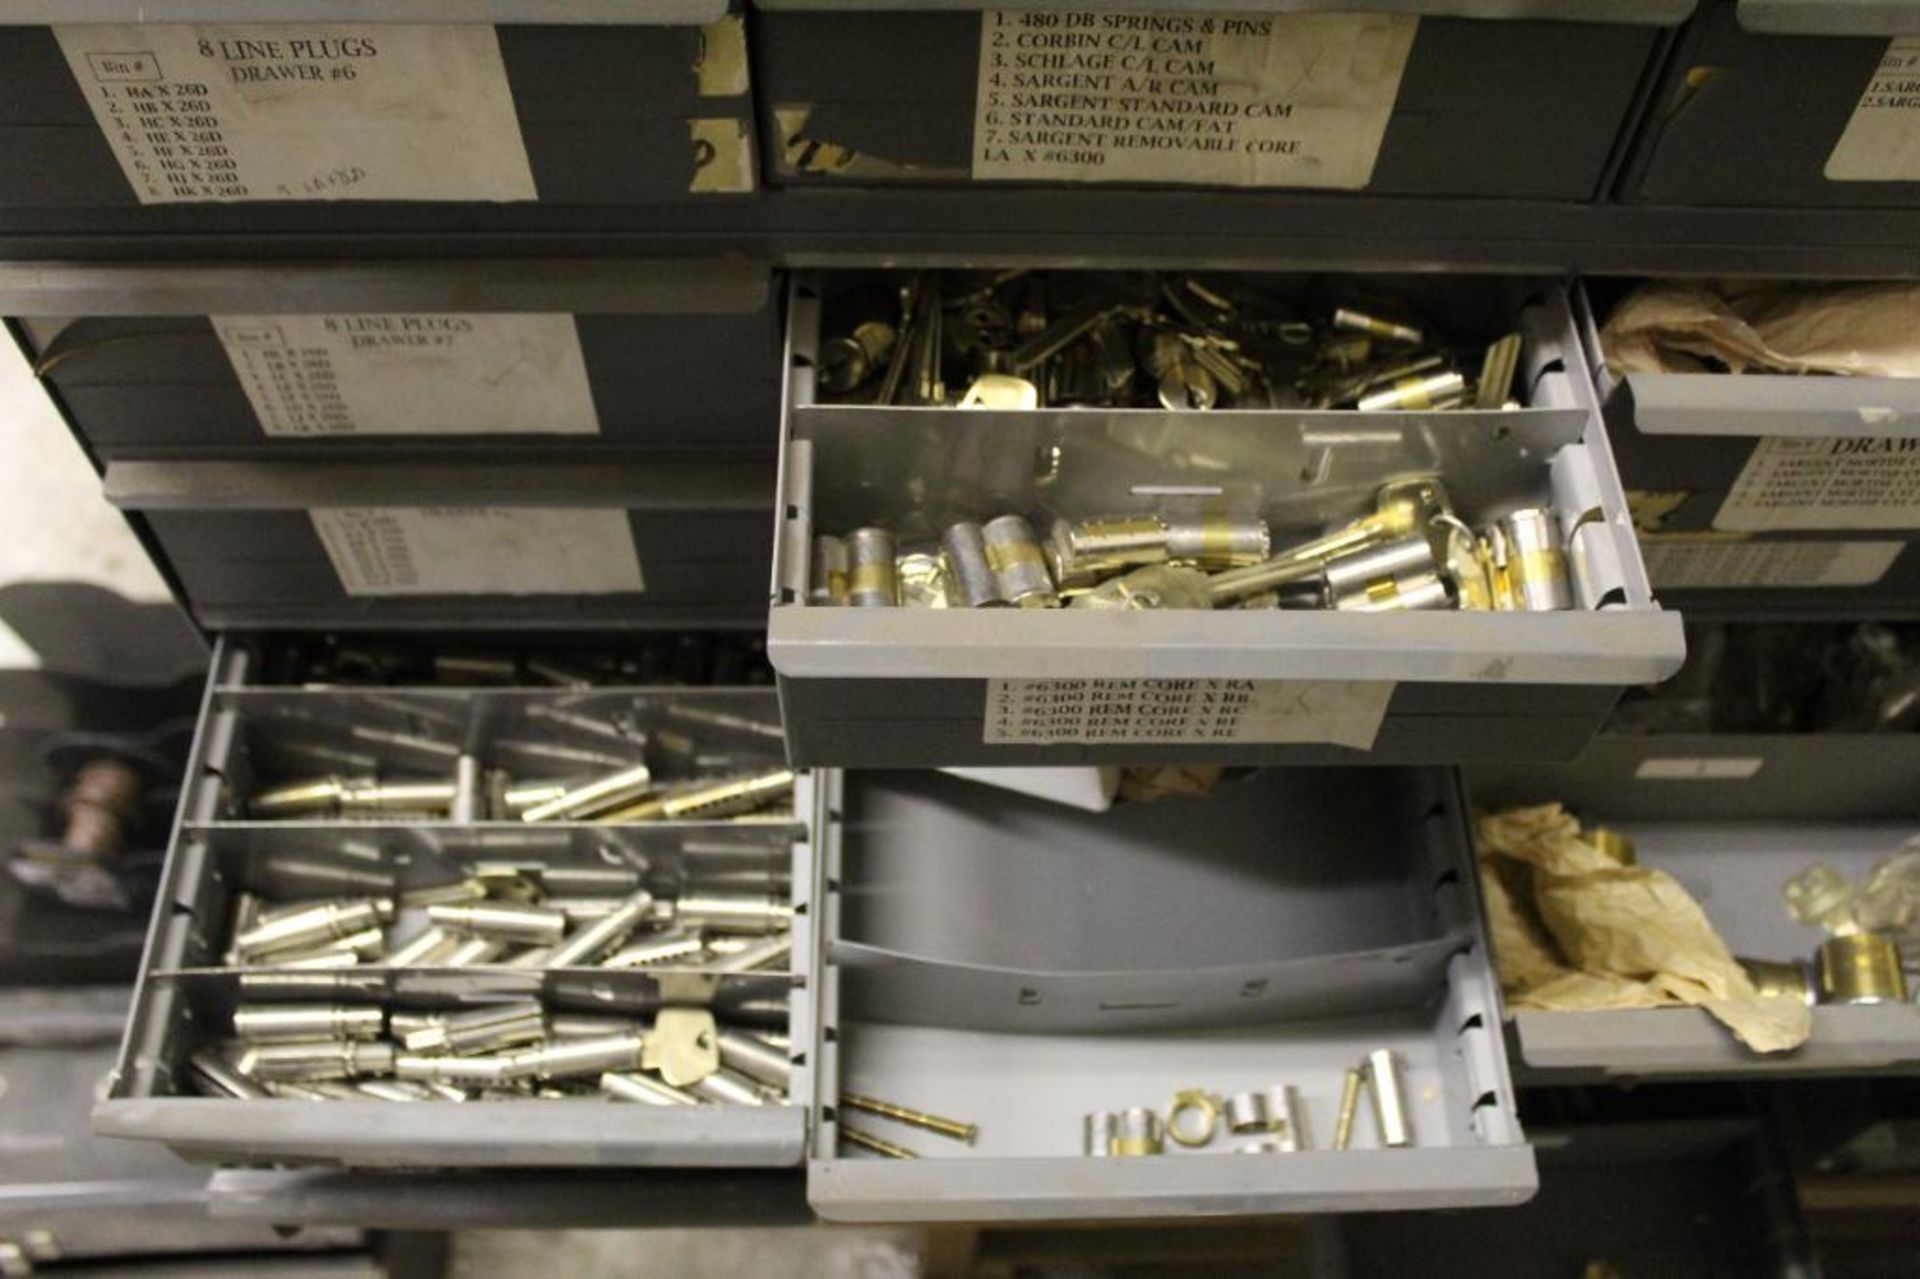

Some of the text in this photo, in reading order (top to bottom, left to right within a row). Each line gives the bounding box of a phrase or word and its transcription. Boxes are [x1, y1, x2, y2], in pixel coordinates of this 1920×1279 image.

[996, 11, 1273, 37] 1. 480 DB SPRINGS & PINS
[198, 37, 377, 61] 8 LINE PLUGS
[992, 32, 1203, 54] 2. CORBIN C/L CAM
[990, 53, 1215, 76] 3. SCHLAGE C/L CAM
[231, 65, 357, 82] DRAWER #6
[156, 85, 169, 96] X
[174, 83, 208, 96] 26D
[988, 73, 1007, 87] 4.
[1012, 74, 1115, 91] SARGENT
[1170, 80, 1219, 97] CAM
[163, 101, 174, 112] X
[180, 100, 211, 112] 26D
[988, 92, 1293, 119] 5. SARGENT STANDARD CAM
[169, 116, 181, 128] X
[186, 116, 218, 128] 26D
[986, 111, 1004, 125] 6.
[1010, 113, 1130, 130] STANDARD
[174, 131, 187, 141] X
[985, 130, 1300, 154] 7. SARGENT REMOVABLE CORE
[179, 145, 193, 156] X
[983, 148, 1106, 166] LA X #6300
[189, 159, 202, 169] X
[344, 316, 391, 332] LINE
[401, 316, 474, 331] PLUGS
[1143, 679, 1198, 691] CORE
[1090, 691, 1135, 702] REM
[1140, 691, 1193, 704] CORE
[1089, 703, 1133, 716] REM
[1138, 702, 1190, 716] CORE
